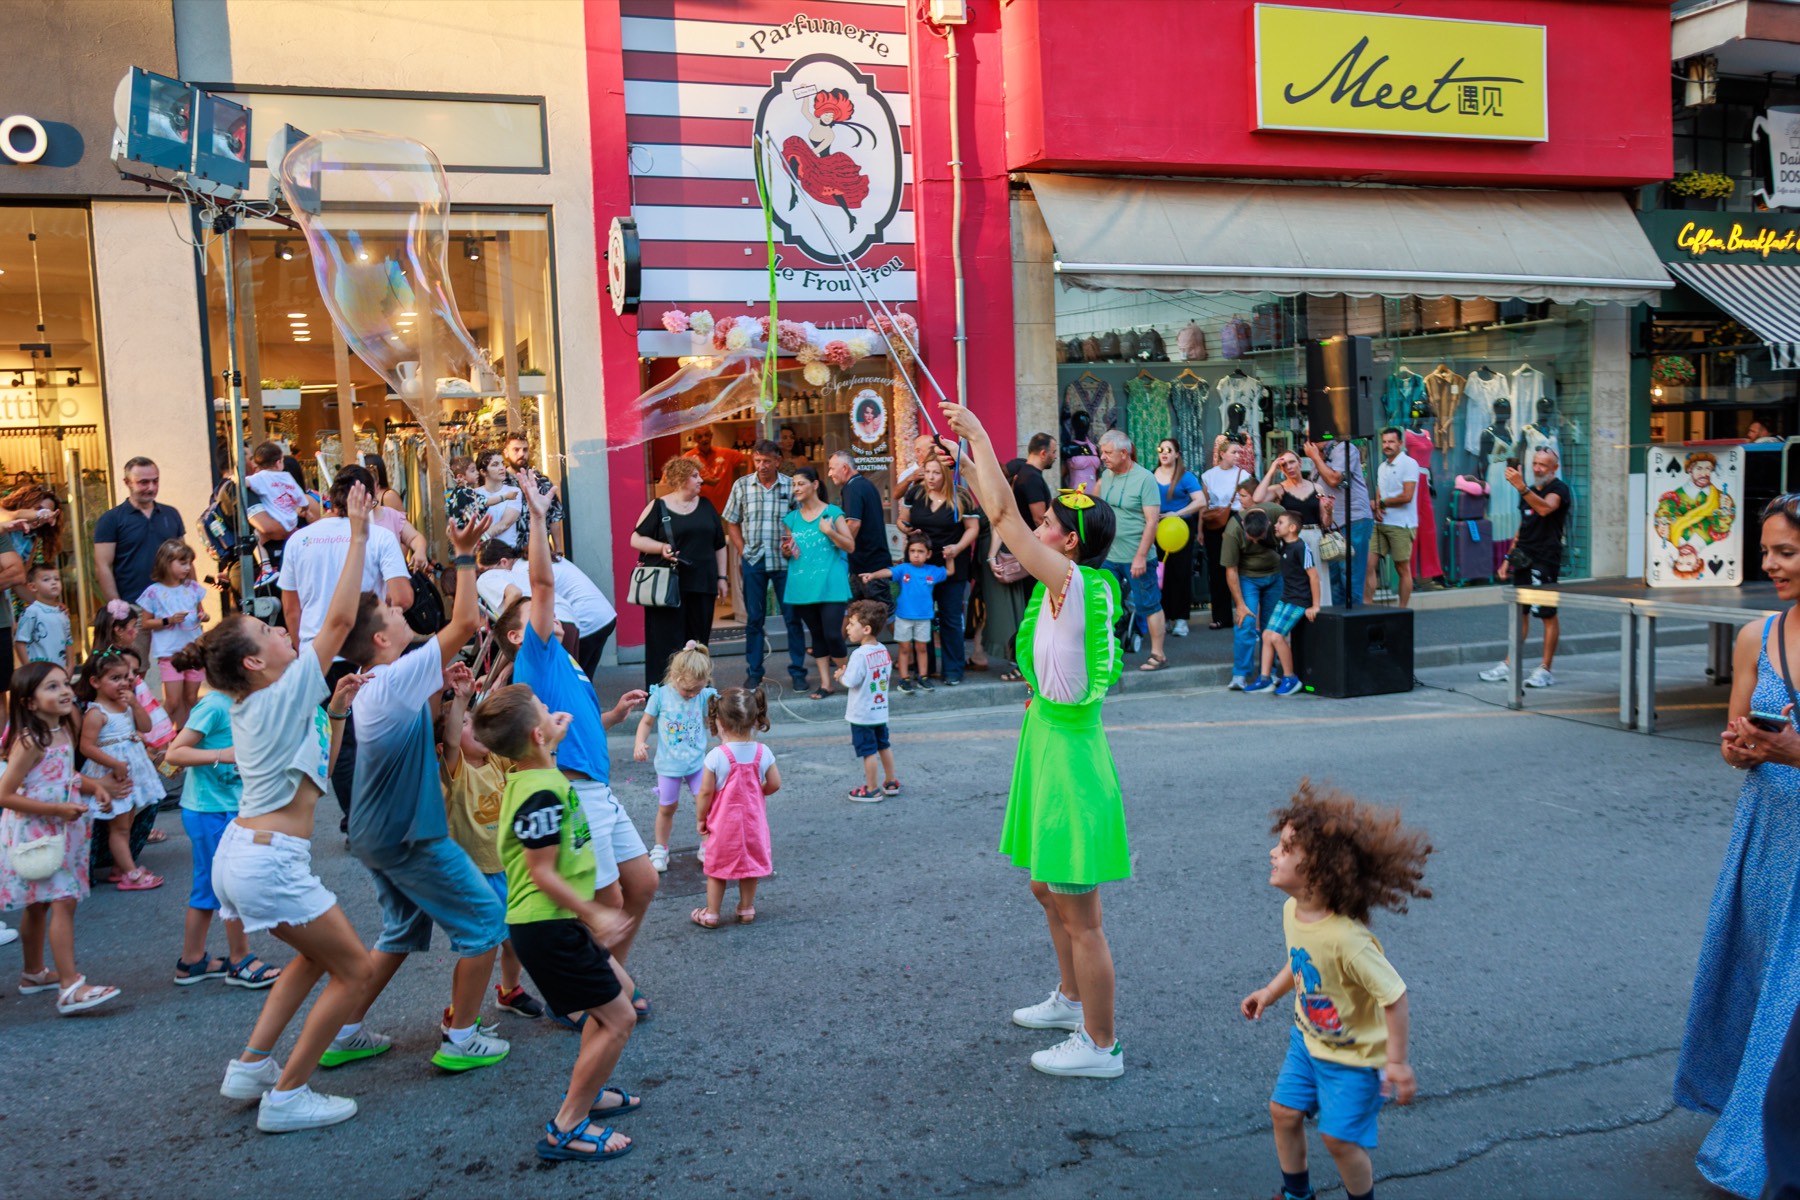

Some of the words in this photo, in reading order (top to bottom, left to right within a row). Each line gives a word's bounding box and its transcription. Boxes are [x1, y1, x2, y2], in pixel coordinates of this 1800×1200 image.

[749, 14, 890, 58] Parfumerie
[1284, 36, 1524, 113] Meet
[1457, 84, 1504, 117] 遇见
[802, 270, 852, 292] Frou
[857, 256, 903, 289] Frou
[0, 391, 80, 420] ttivo
